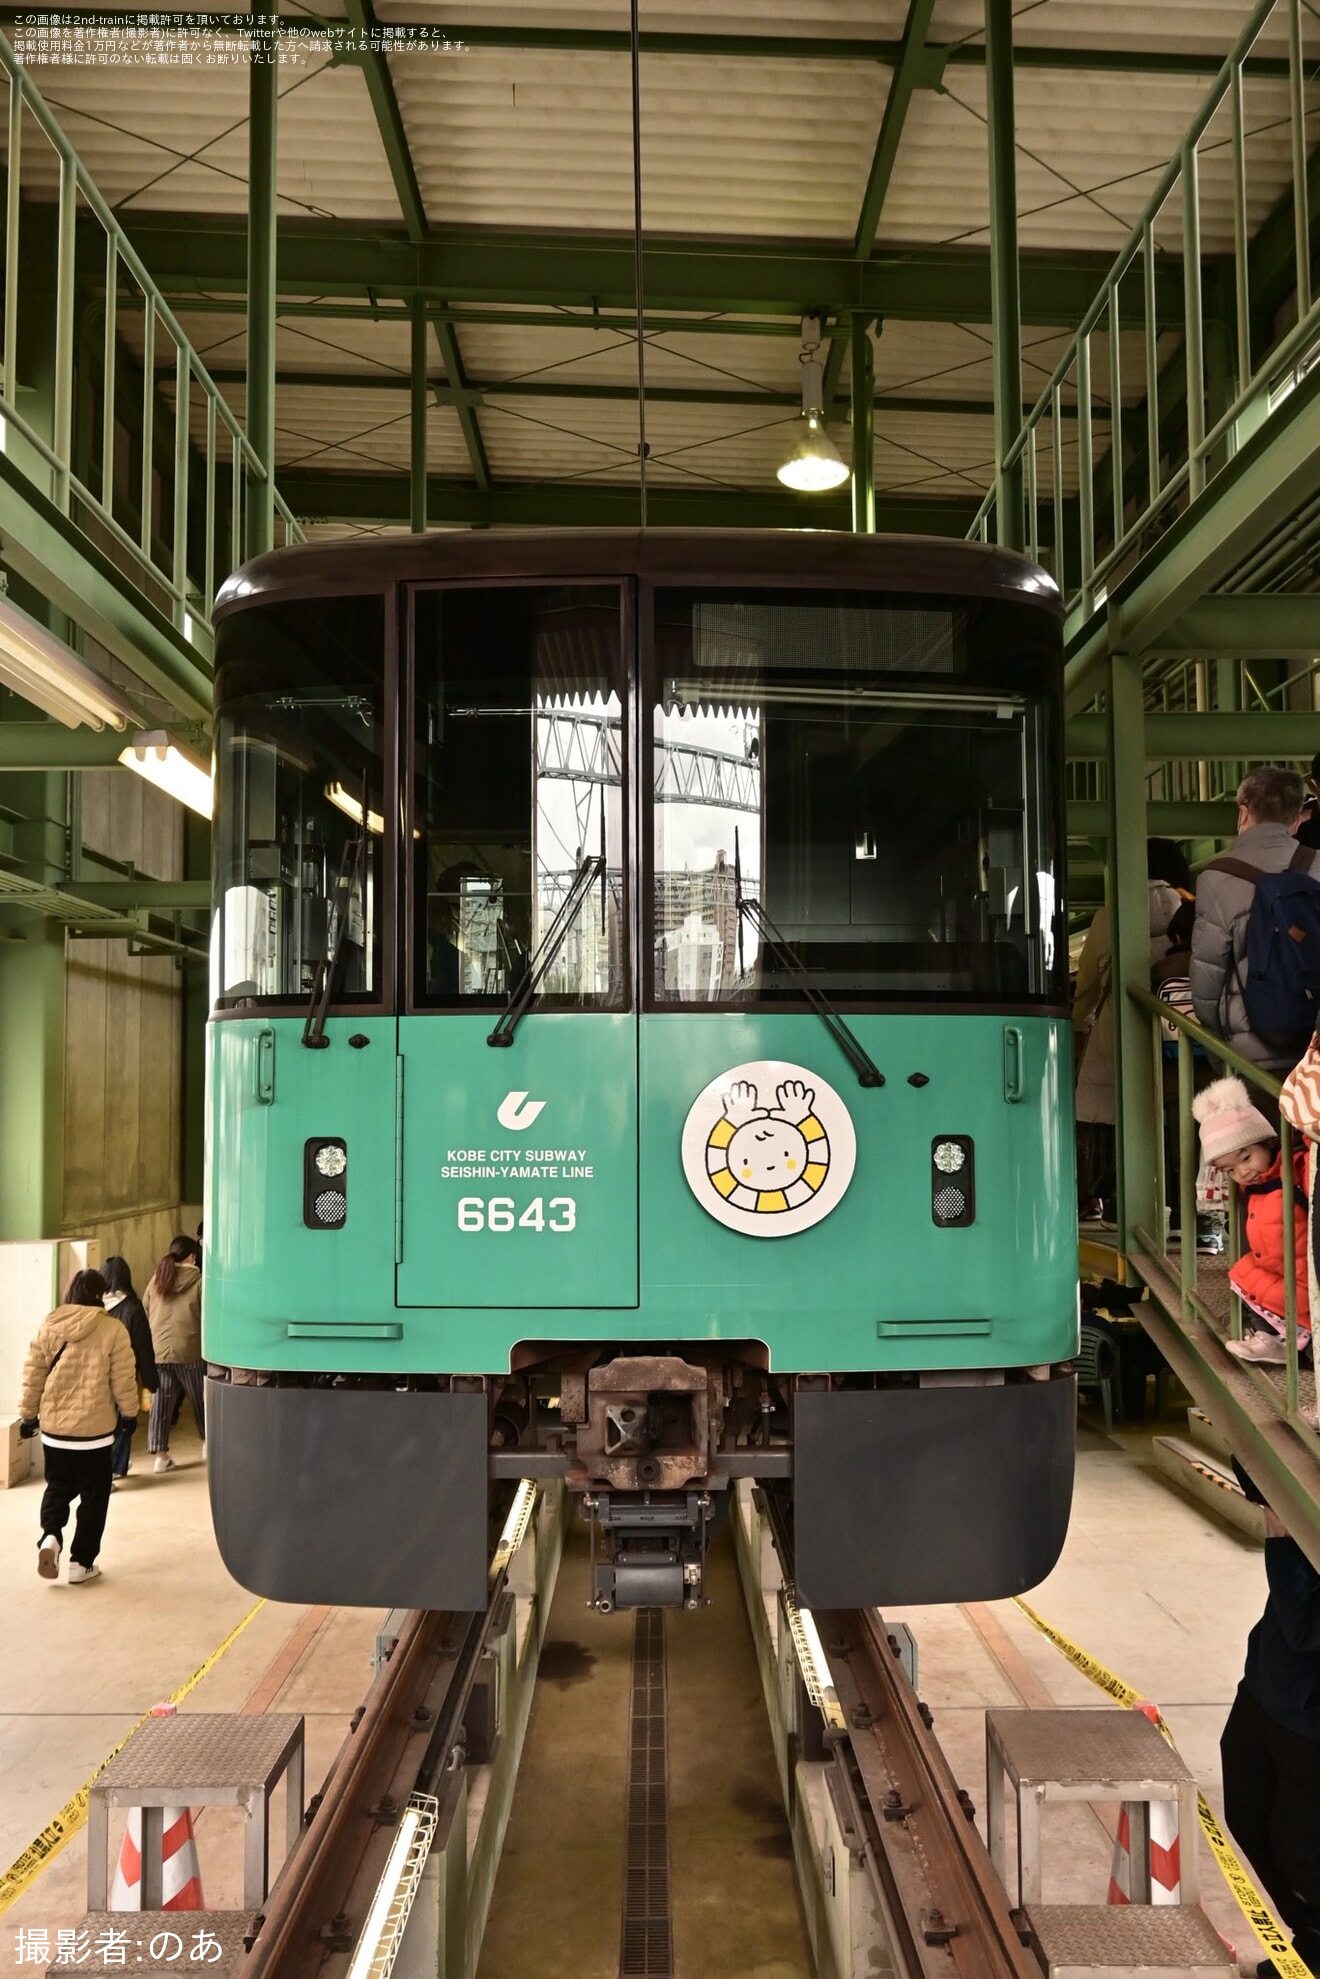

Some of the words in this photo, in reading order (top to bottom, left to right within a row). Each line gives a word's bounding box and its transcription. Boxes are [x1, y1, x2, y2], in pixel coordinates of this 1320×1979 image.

[447, 1150, 486, 1161] KOBE
[490, 1150, 521, 1161] CITY
[525, 1150, 587, 1161] SUBWAY
[441, 1166, 558, 1178] SEISHIN-YAMATE
[562, 1166, 593, 1178] LINE
[457, 1197, 576, 1232] 6643
